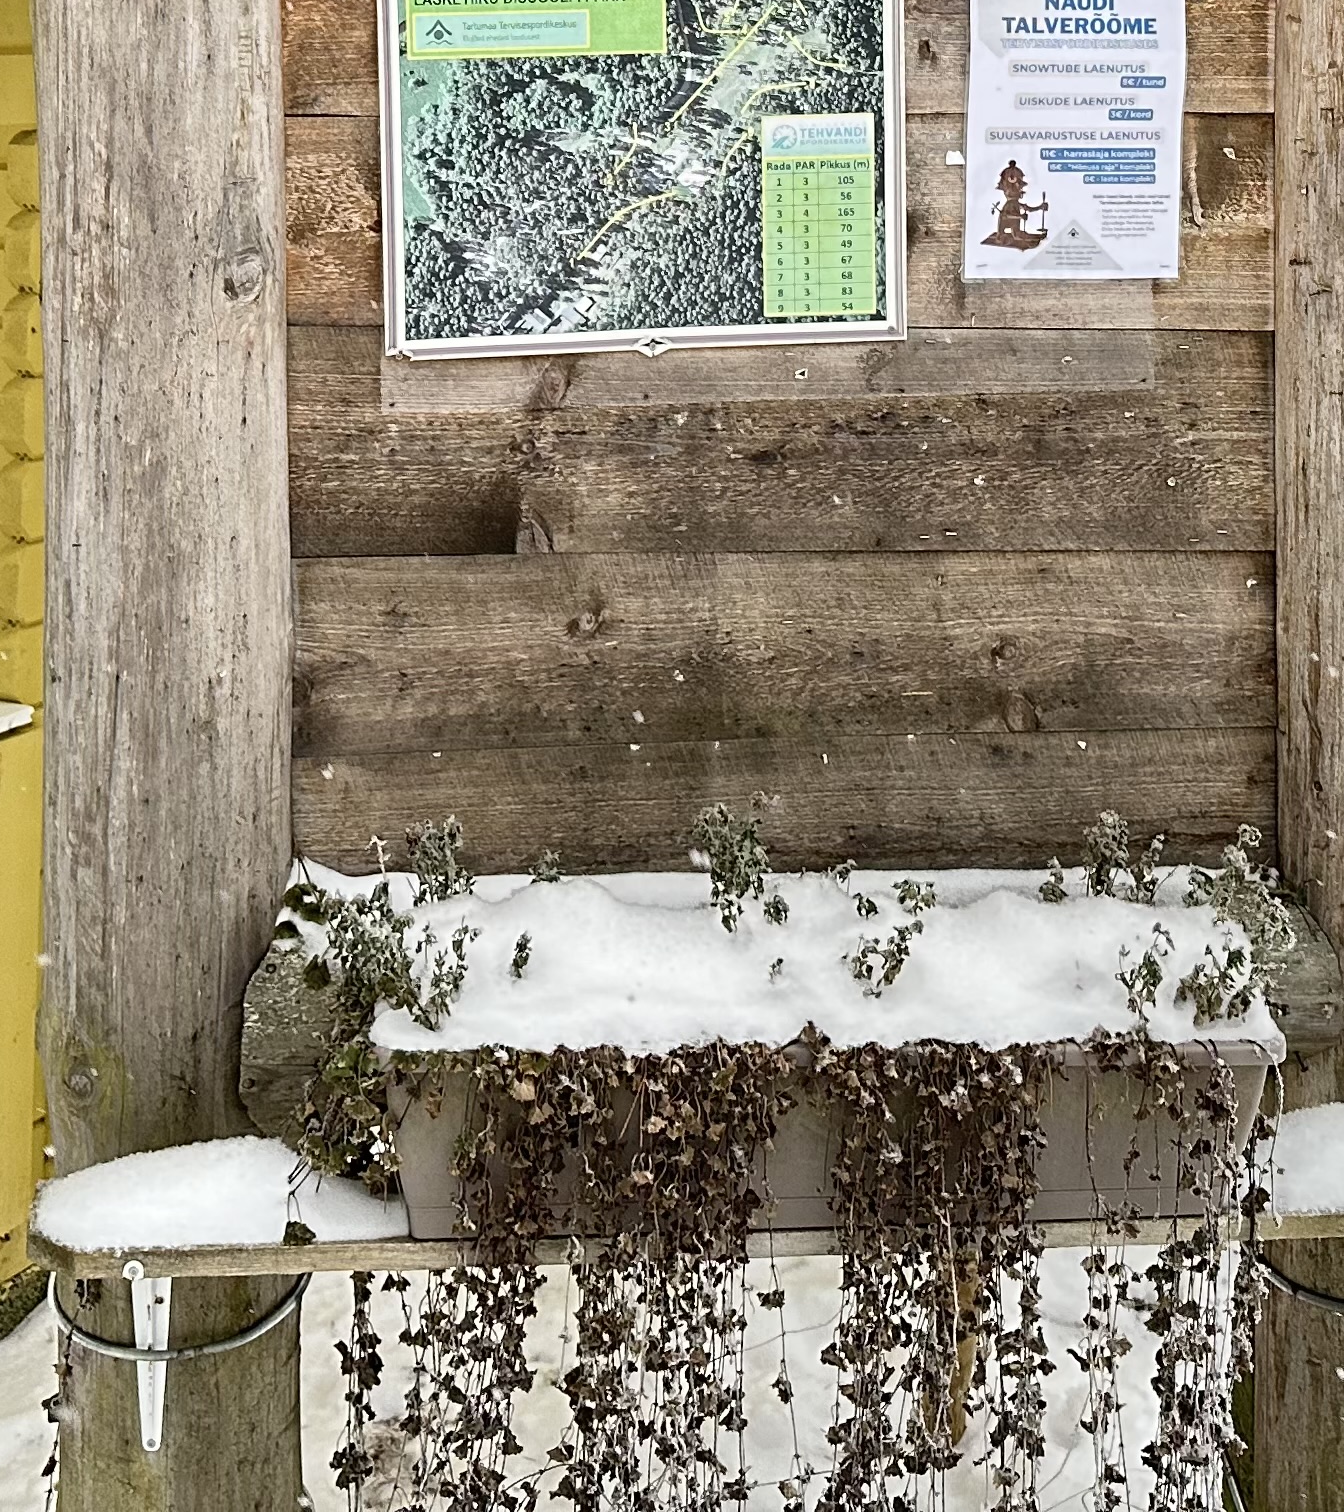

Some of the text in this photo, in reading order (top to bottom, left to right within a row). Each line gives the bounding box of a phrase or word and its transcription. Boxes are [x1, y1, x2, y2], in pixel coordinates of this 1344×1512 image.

[462, 21, 497, 31] Tartumaa
[1001, 12, 1158, 35] TALVERÕÕME
[1012, 63, 1146, 74] SNOWTUBE LAENUTUS
[1019, 97, 1136, 106] UISKUDE LAENUTUS
[800, 126, 867, 139] TEHVANDI
[989, 130, 1161, 141] SUUSAVARUSTUSE LAENUTUS
[766, 158, 870, 171] Rada PAR Pikkus (m)
[776, 176, 855, 186] 1 3 105
[776, 192, 852, 202] 2 3 56
[777, 208, 855, 218] 3 4 165
[777, 224, 853, 234] 4 3 70
[777, 240, 853, 250] 5 3 49
[778, 256, 852, 266] 6 3 67
[778, 271, 853, 282] 7 3 68
[778, 287, 853, 297] 8 3 83
[842, 302, 853, 310] 54
